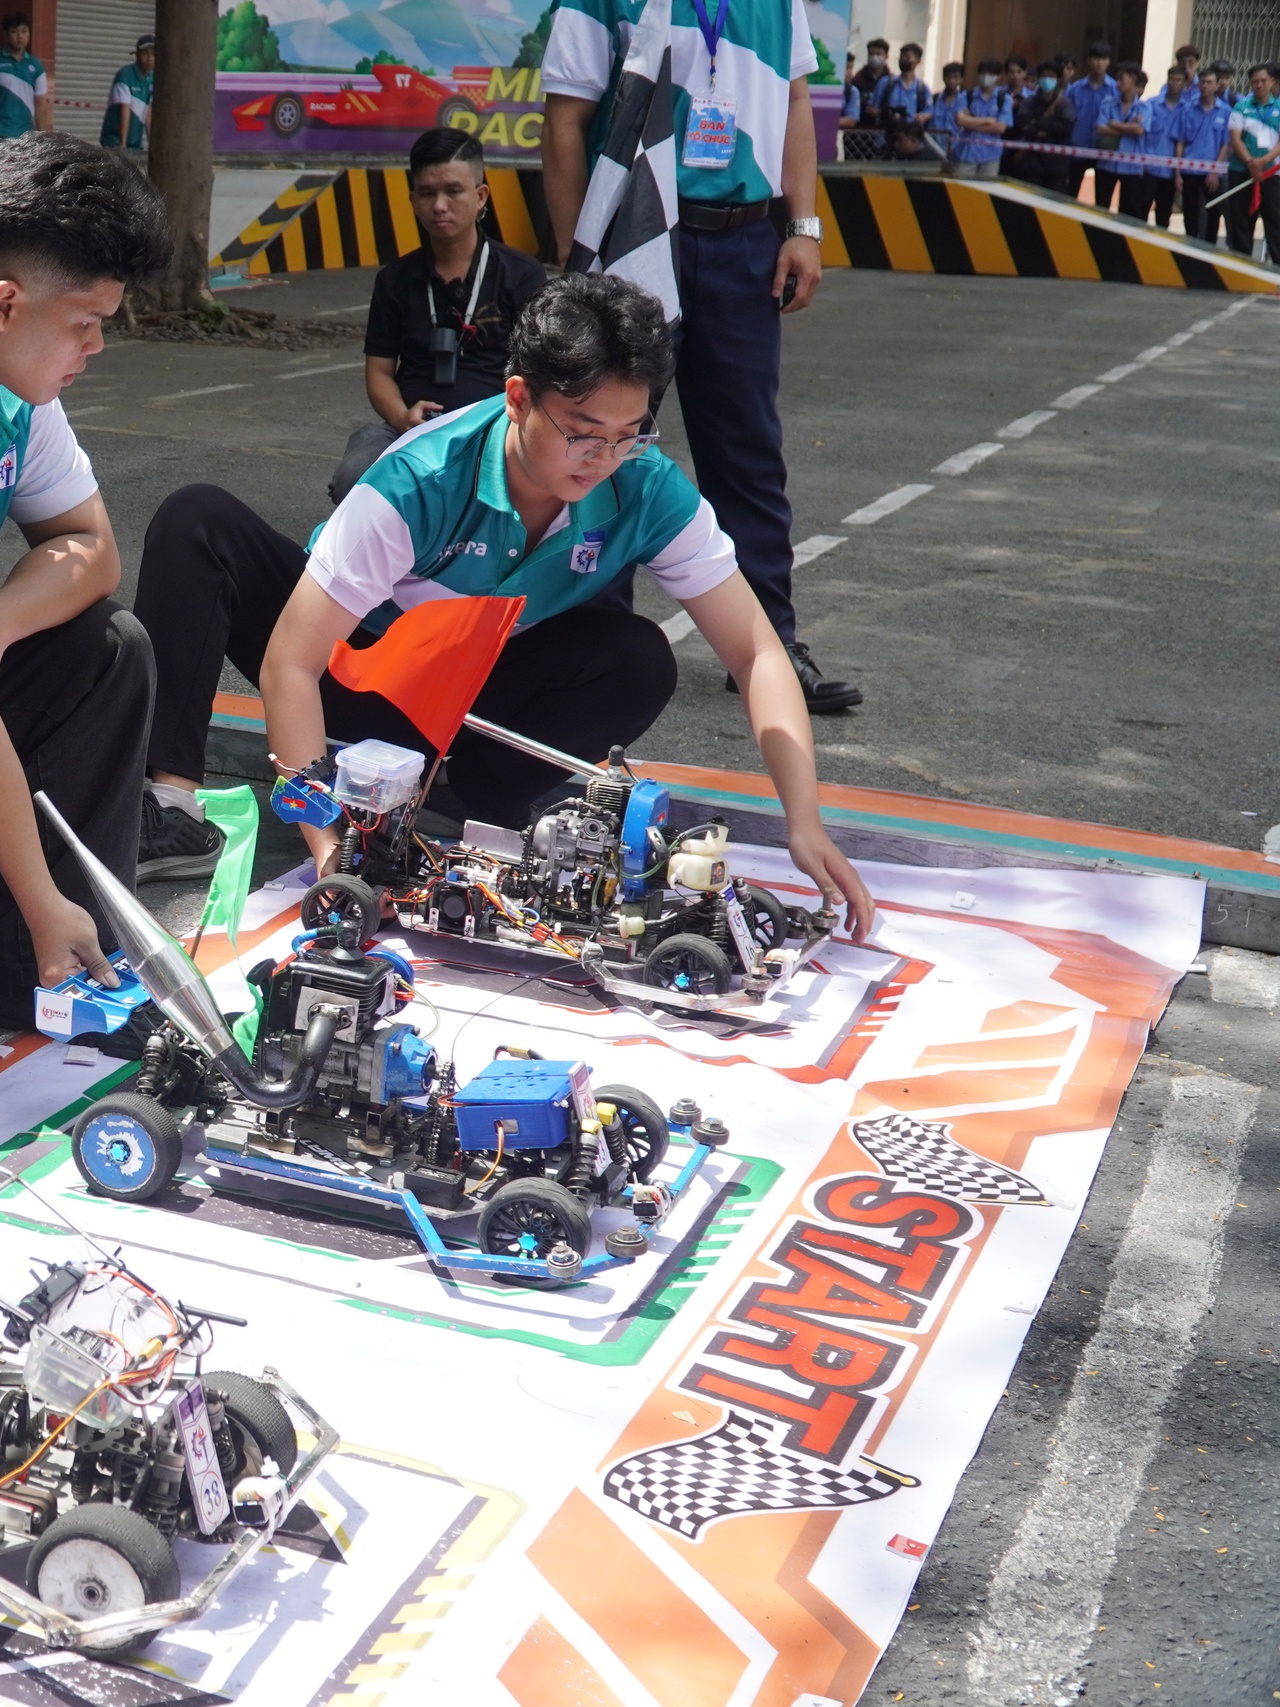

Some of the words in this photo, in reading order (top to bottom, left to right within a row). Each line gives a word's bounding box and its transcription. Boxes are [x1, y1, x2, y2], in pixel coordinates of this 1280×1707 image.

[485, 67, 547, 103] MI
[310, 103, 336, 111] RACING
[450, 111, 545, 149] RAC
[699, 120, 726, 131] BAN
[678, 1175, 974, 1466] START
[204, 1480, 220, 1516] 38
